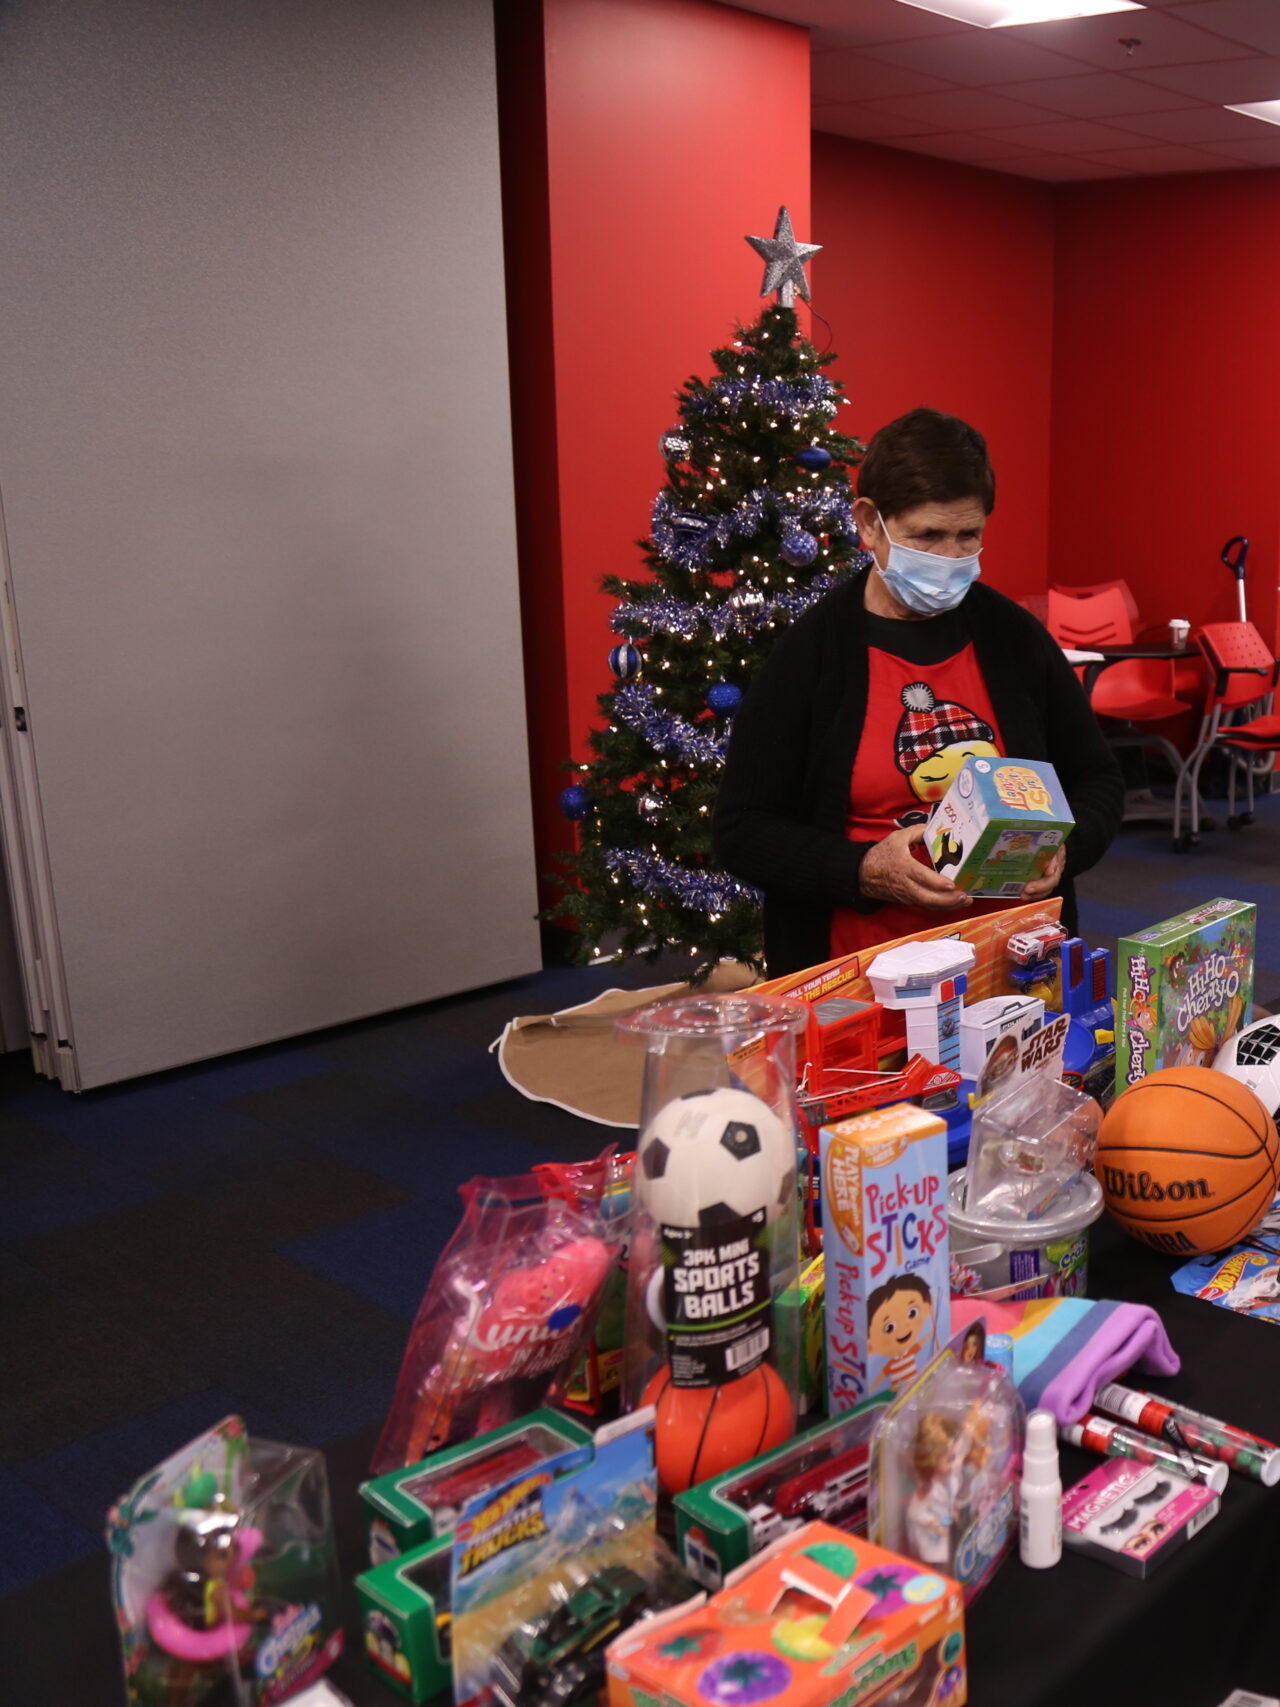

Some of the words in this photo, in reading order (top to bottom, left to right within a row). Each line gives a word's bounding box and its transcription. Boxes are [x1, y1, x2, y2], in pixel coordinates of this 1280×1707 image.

[1021, 1031, 1067, 1073] WARS
[1022, 1018, 1068, 1057] STAR
[832, 1158, 849, 1212] HERE
[844, 1146, 860, 1188] PLAY
[1102, 1164, 1212, 1202] Wilson
[865, 1173, 939, 1225] Pick-up
[682, 1248, 716, 1268] 3PK
[718, 1237, 750, 1263] MINI
[866, 1203, 948, 1278] STICKS
[672, 1250, 761, 1293] SPORTS
[904, 1256, 931, 1273] Game
[683, 1280, 755, 1319] BALLS
[1066, 1472, 1136, 1530] MAGNETIC
